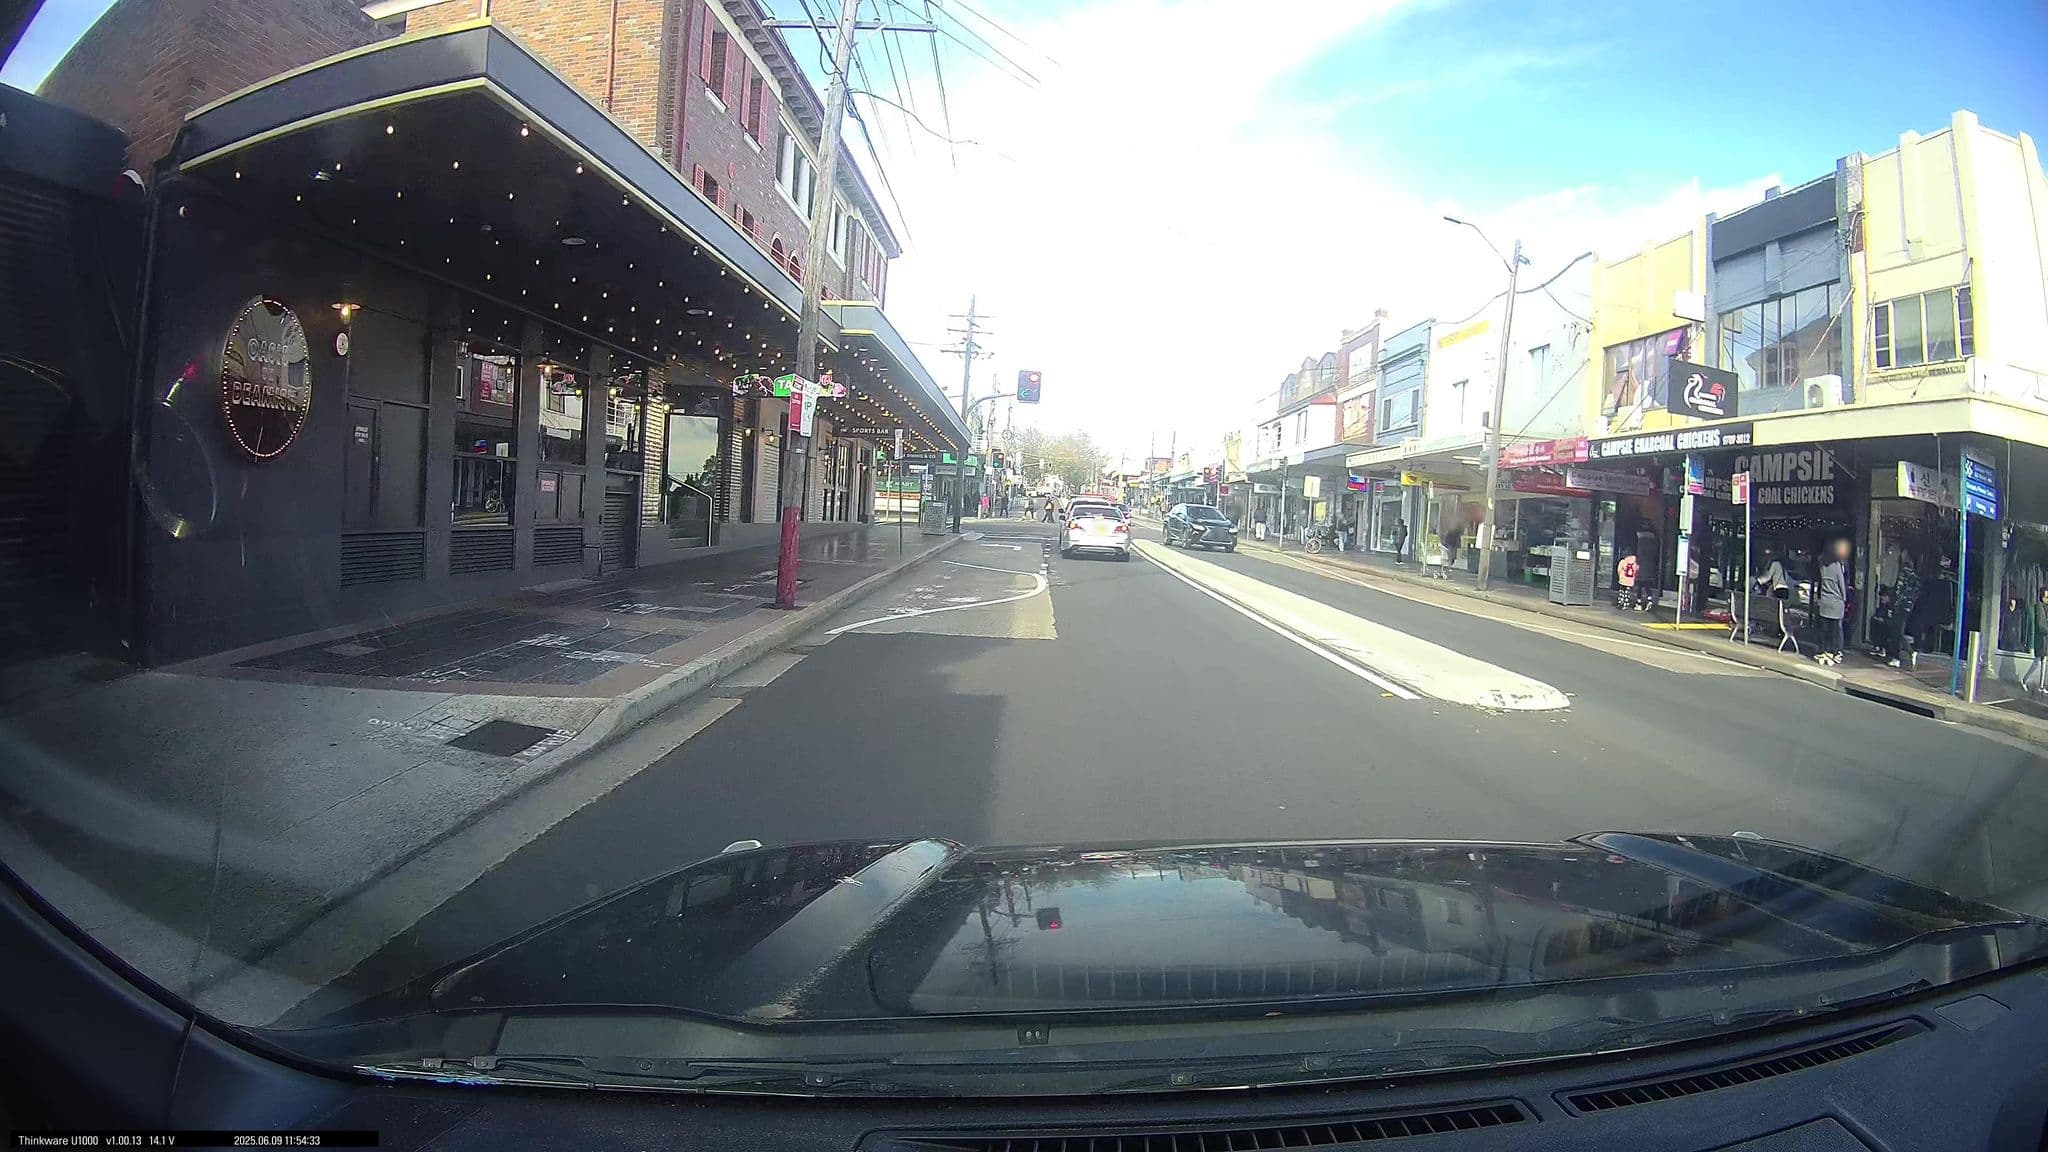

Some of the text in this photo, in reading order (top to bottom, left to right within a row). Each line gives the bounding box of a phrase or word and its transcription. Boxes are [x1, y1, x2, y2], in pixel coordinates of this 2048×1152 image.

[1600, 438, 1634, 458] CAMPSIE
[1634, 433, 1675, 454] CHARCOAL
[1676, 428, 1721, 450] CHICKENS
[1734, 449, 1835, 483] CAMPSIE
[1783, 485, 1834, 504] CHICKENS
